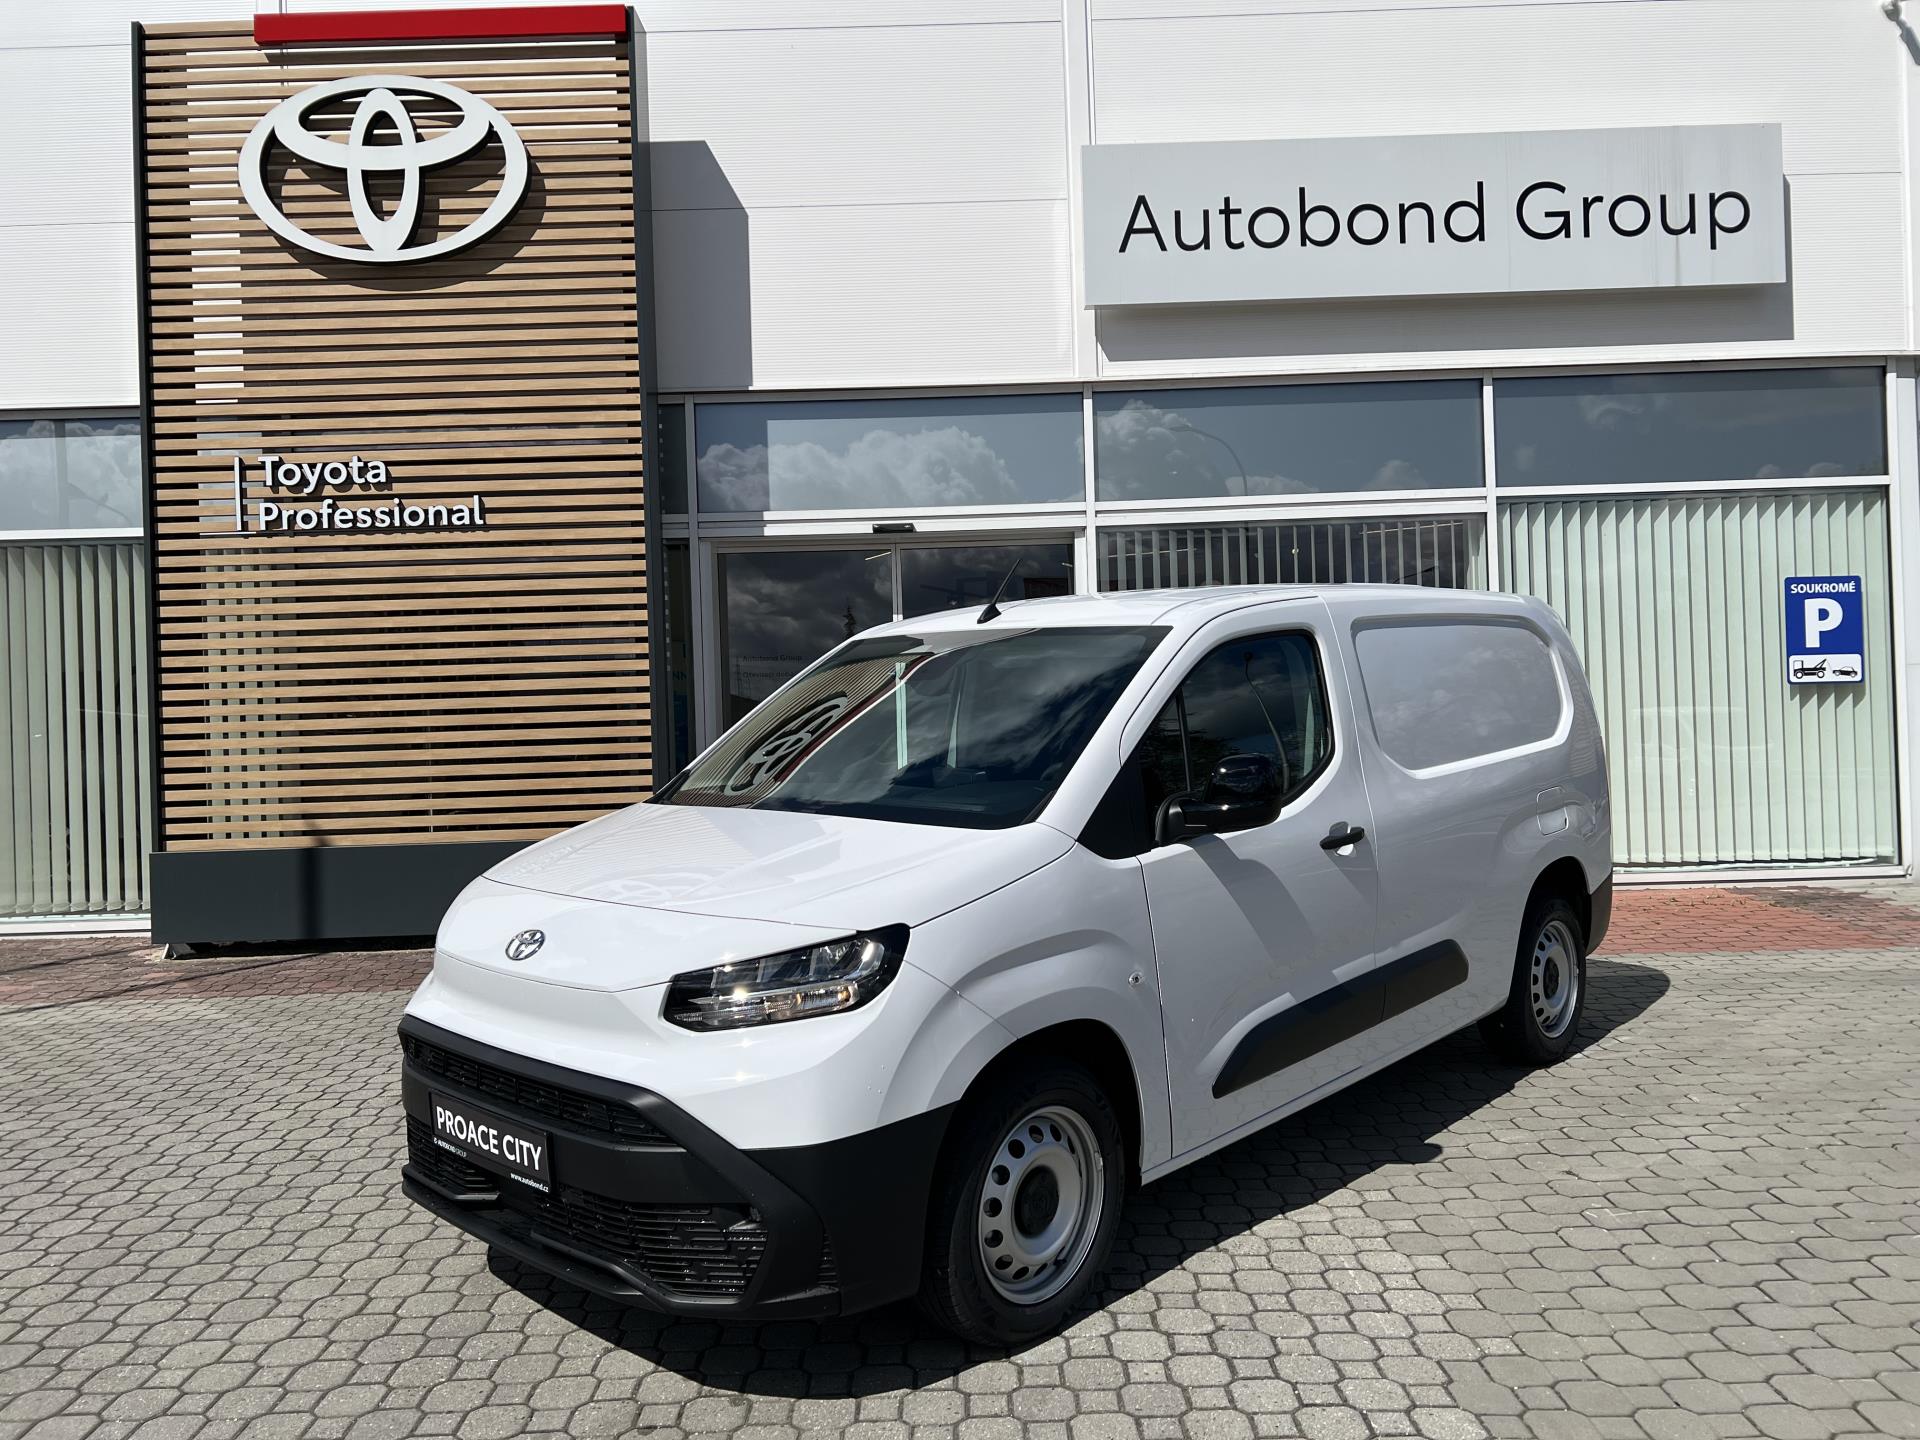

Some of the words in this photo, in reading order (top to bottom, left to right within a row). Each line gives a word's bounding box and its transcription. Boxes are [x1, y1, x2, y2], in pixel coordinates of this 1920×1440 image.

[1118, 181, 1486, 253] Autobond
[1516, 181, 1751, 250] Group
[258, 455, 388, 493] Toyota
[258, 494, 485, 529] Professional
[1790, 581, 1856, 594] SOUKROMÉ
[1804, 597, 1844, 648] P
[436, 1106, 499, 1155] PROACE
[502, 1134, 542, 1171] CITY
